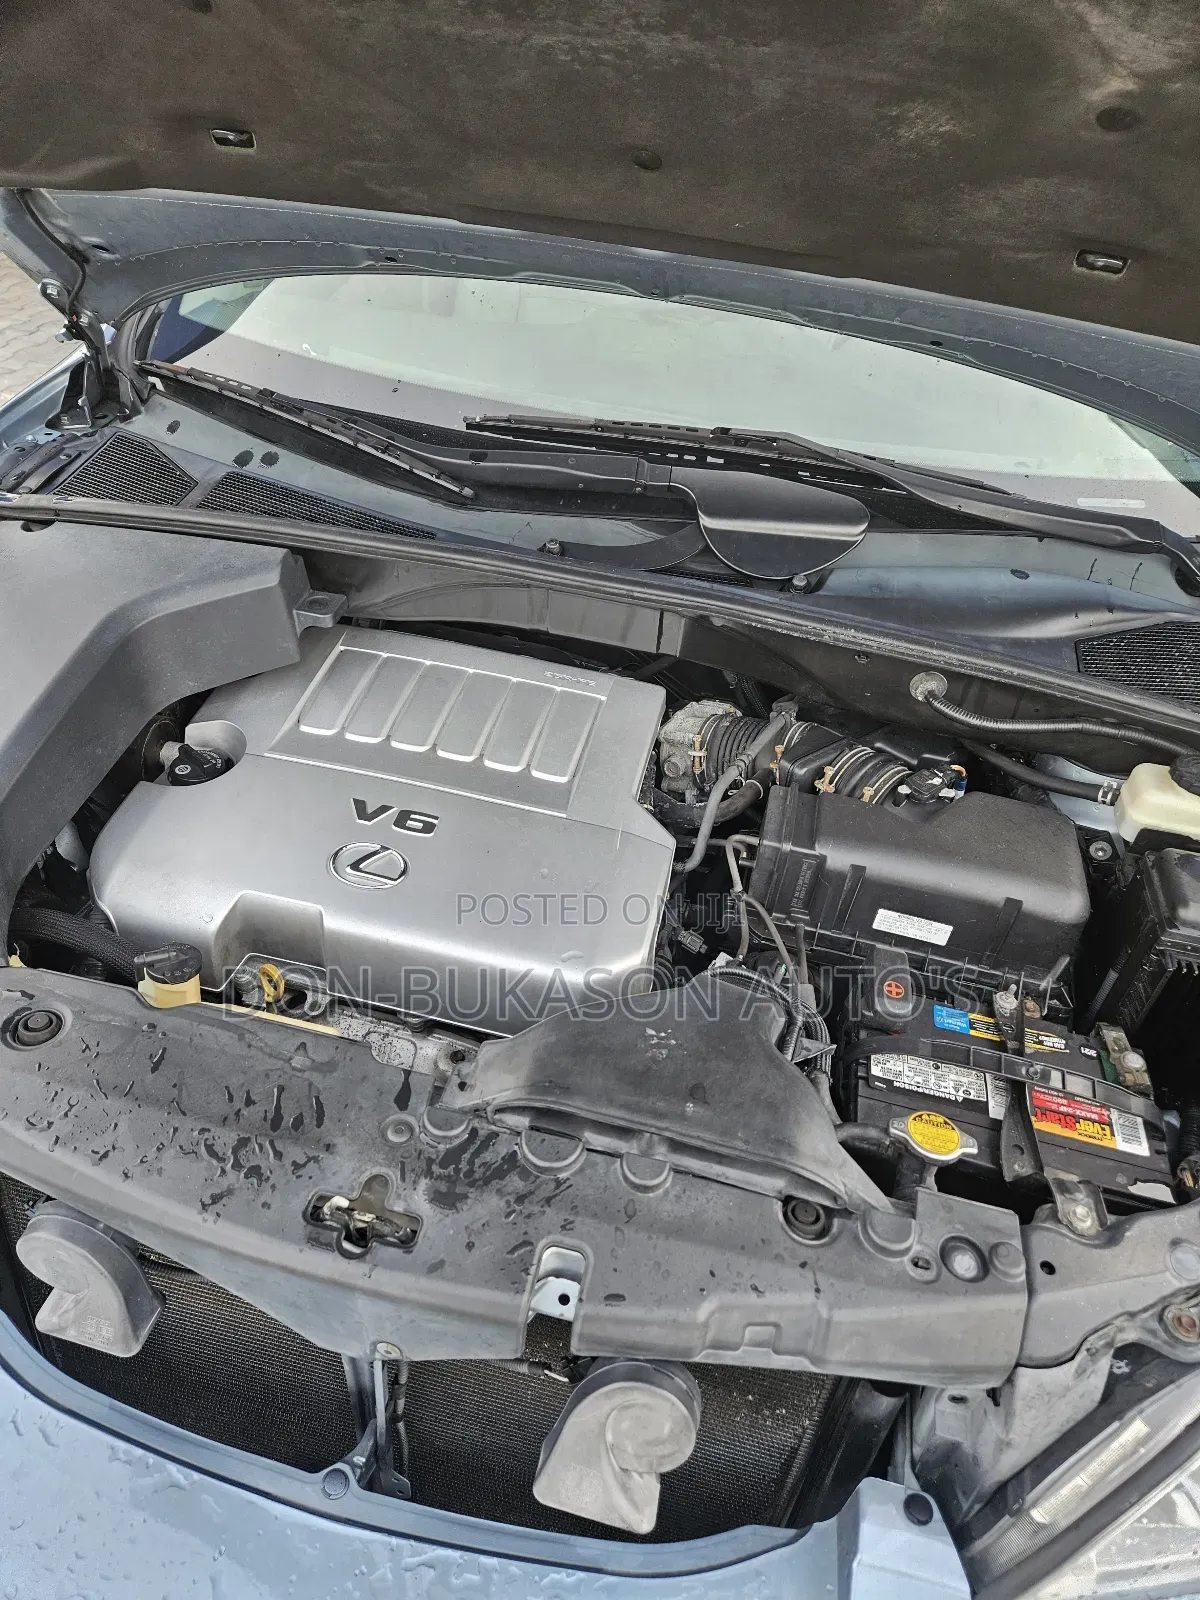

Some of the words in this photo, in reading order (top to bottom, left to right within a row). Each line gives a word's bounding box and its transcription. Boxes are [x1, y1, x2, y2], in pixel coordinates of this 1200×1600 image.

[351, 798, 440, 837] V6
[893, 1080, 956, 1101] DANGER/POISON
[915, 1116, 953, 1130] CAUTION
[1034, 1108, 1113, 1141] EverStart
